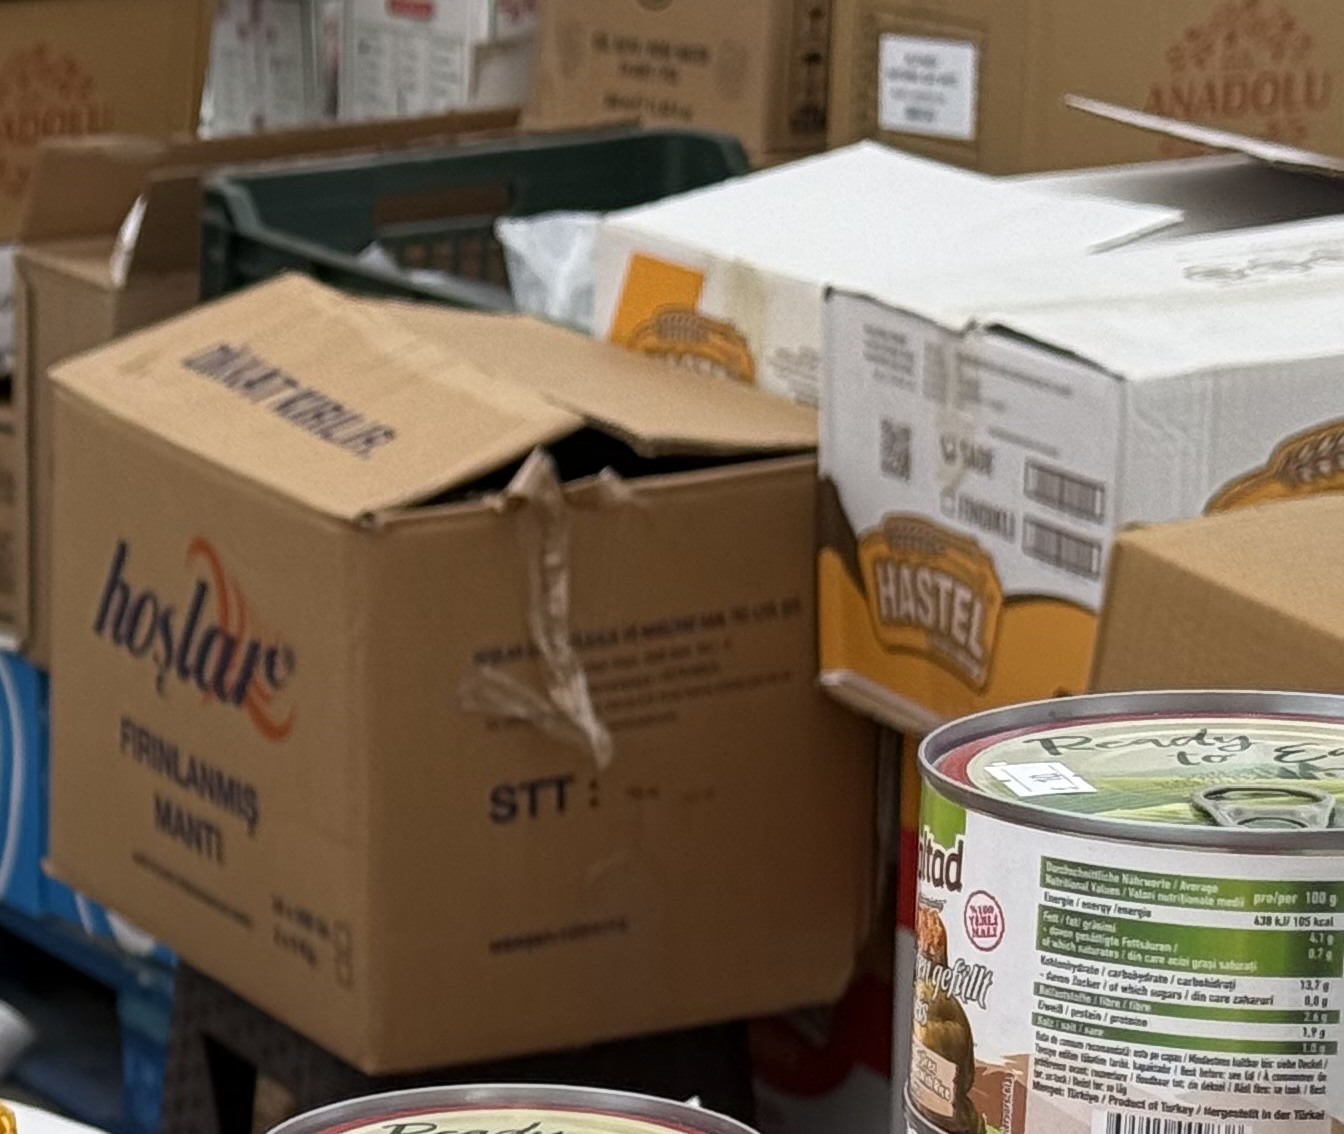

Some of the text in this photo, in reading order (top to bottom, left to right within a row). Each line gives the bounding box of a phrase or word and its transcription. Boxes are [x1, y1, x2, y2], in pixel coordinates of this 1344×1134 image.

[875, 556, 988, 663] HASTEL
[1022, 728, 1255, 757] Ready
[1168, 748, 1236, 767] to
[488, 776, 576, 825] STT
